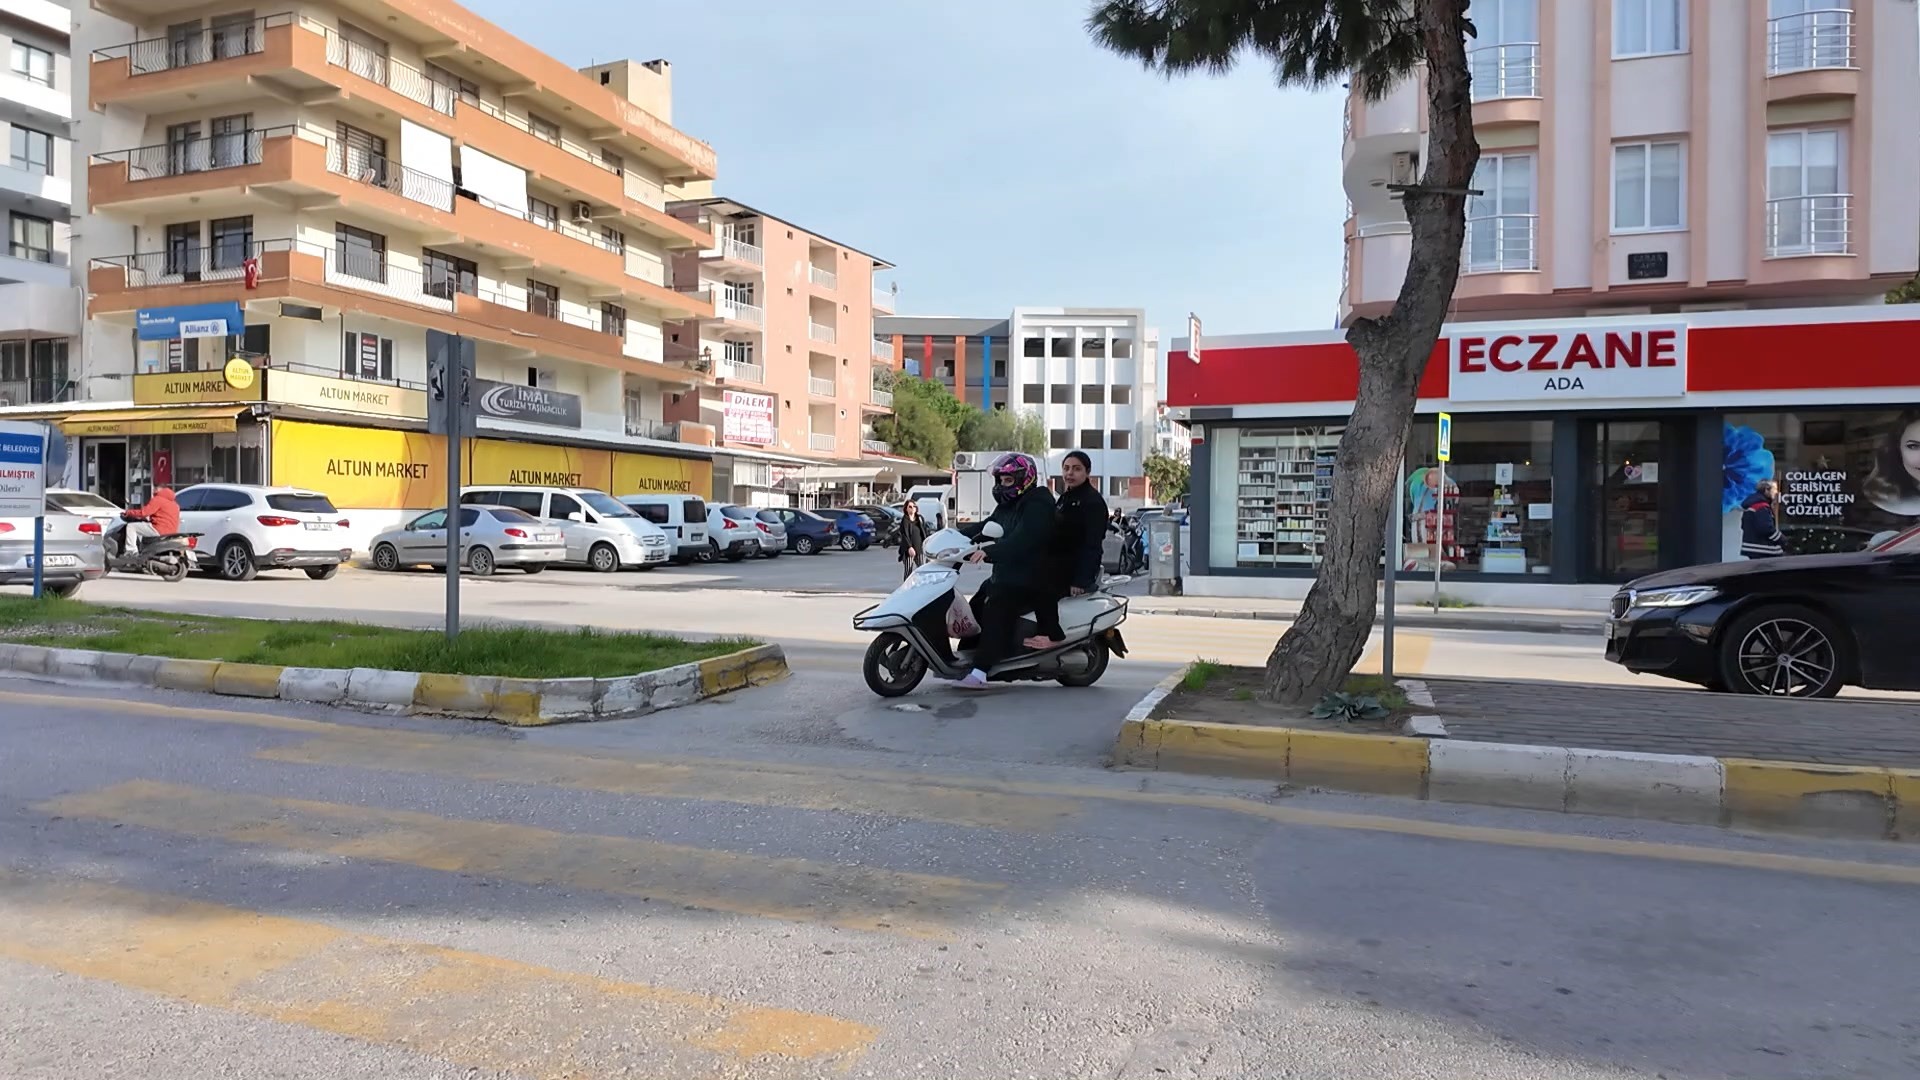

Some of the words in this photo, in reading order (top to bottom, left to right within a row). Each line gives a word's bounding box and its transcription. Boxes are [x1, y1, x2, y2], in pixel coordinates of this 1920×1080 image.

[185, 324, 209, 334] Allianz
[1459, 330, 1676, 373] ECZANE
[164, 381, 191, 394] ALTUN
[192, 380, 227, 393] MARKET
[1543, 376, 1585, 391] ADA
[319, 385, 350, 401] ALTUN
[352, 388, 390, 406] MARKET
[518, 386, 550, 405] İMAL
[499, 398, 527, 409] TURİZM
[188, 422, 208, 430] MARKET
[3, 443, 40, 454] BELEDİYESİ
[326, 459, 371, 477] ALTUN
[375, 462, 429, 479] MARKET
[509, 469, 541, 485] ALTUN
[543, 471, 582, 487] MARKET
[1785, 471, 1847, 481] COLLAGEN
[638, 477, 663, 490] ALTUN
[663, 479, 691, 492] MARKET
[1789, 481, 1841, 493] SERİSİYLE
[1778, 492, 1813, 505] İÇTEN
[1816, 493, 1855, 504] GELEN
[1786, 503, 1842, 516] GÜZELLİK
